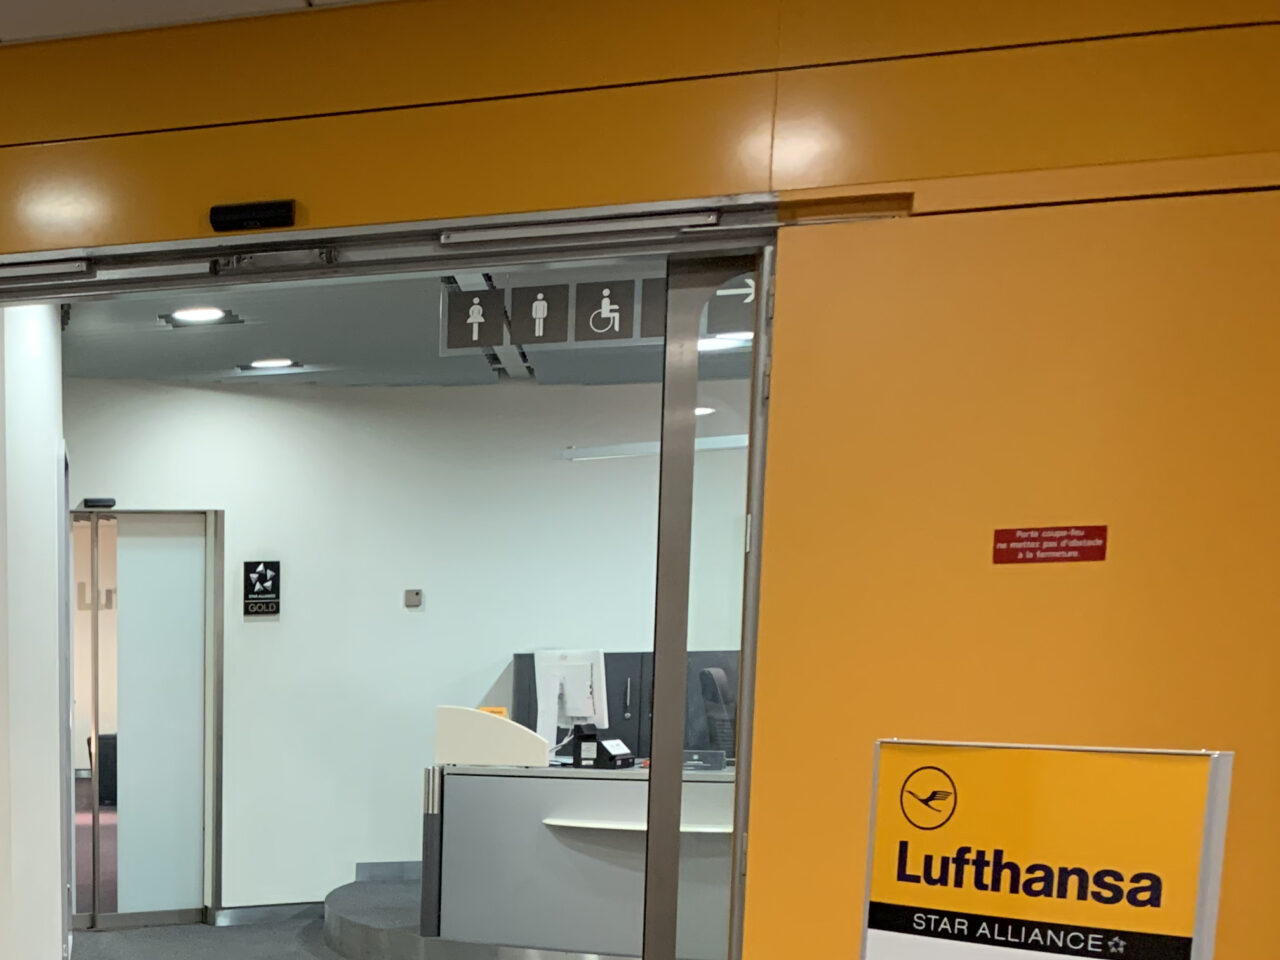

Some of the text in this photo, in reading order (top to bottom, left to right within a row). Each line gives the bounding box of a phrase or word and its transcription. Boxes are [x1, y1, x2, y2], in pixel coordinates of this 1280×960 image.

[248, 603, 276, 612] GOLD
[896, 840, 1164, 908] Lufthansa
[913, 912, 1103, 952] STAR ALLIANCE
